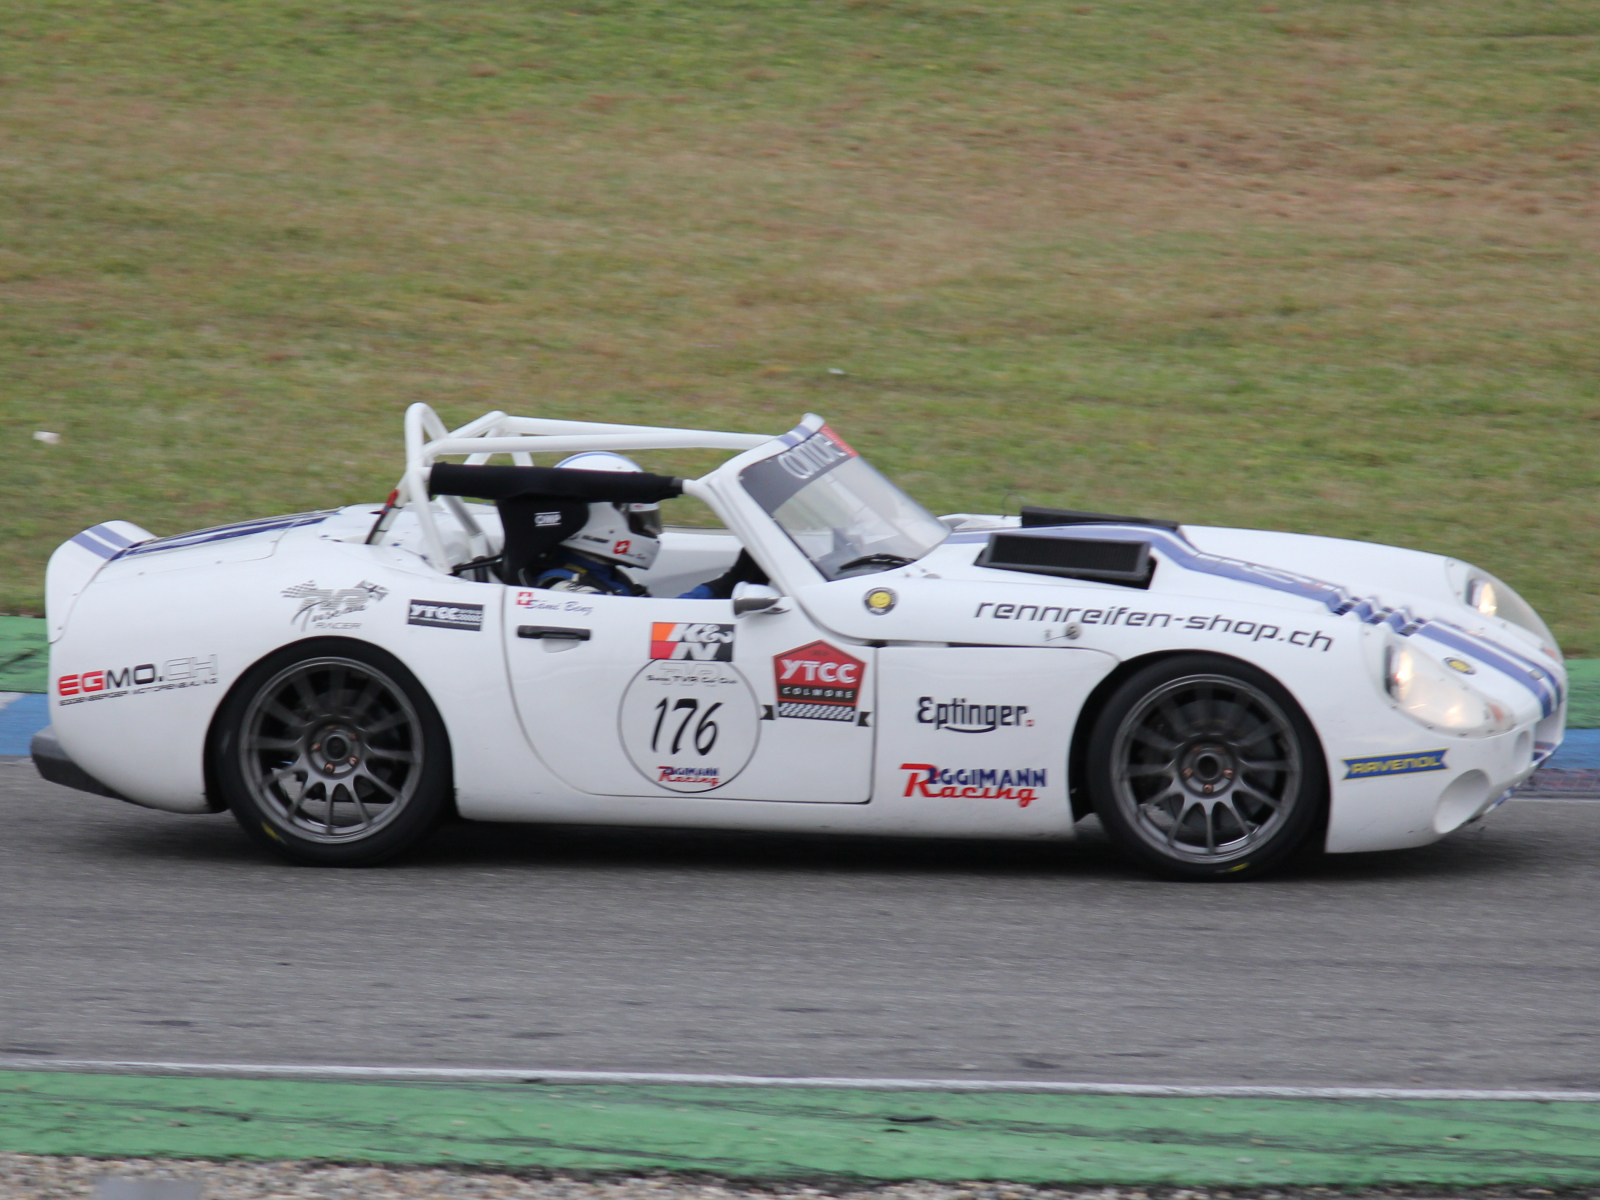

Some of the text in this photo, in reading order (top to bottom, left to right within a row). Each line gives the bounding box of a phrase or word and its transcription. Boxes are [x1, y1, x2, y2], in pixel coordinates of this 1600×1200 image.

[409, 604, 460, 620] YTCC
[974, 601, 1334, 652] rennreifen-shop.ch
[58, 653, 218, 697] EGMO.CH
[780, 658, 858, 684] YTCC
[782, 686, 854, 699] COLMORE
[651, 697, 725, 756] 176
[917, 696, 1028, 733] Eptinger
[1351, 755, 1442, 774] RAVENOL
[899, 763, 1040, 808] Racing
